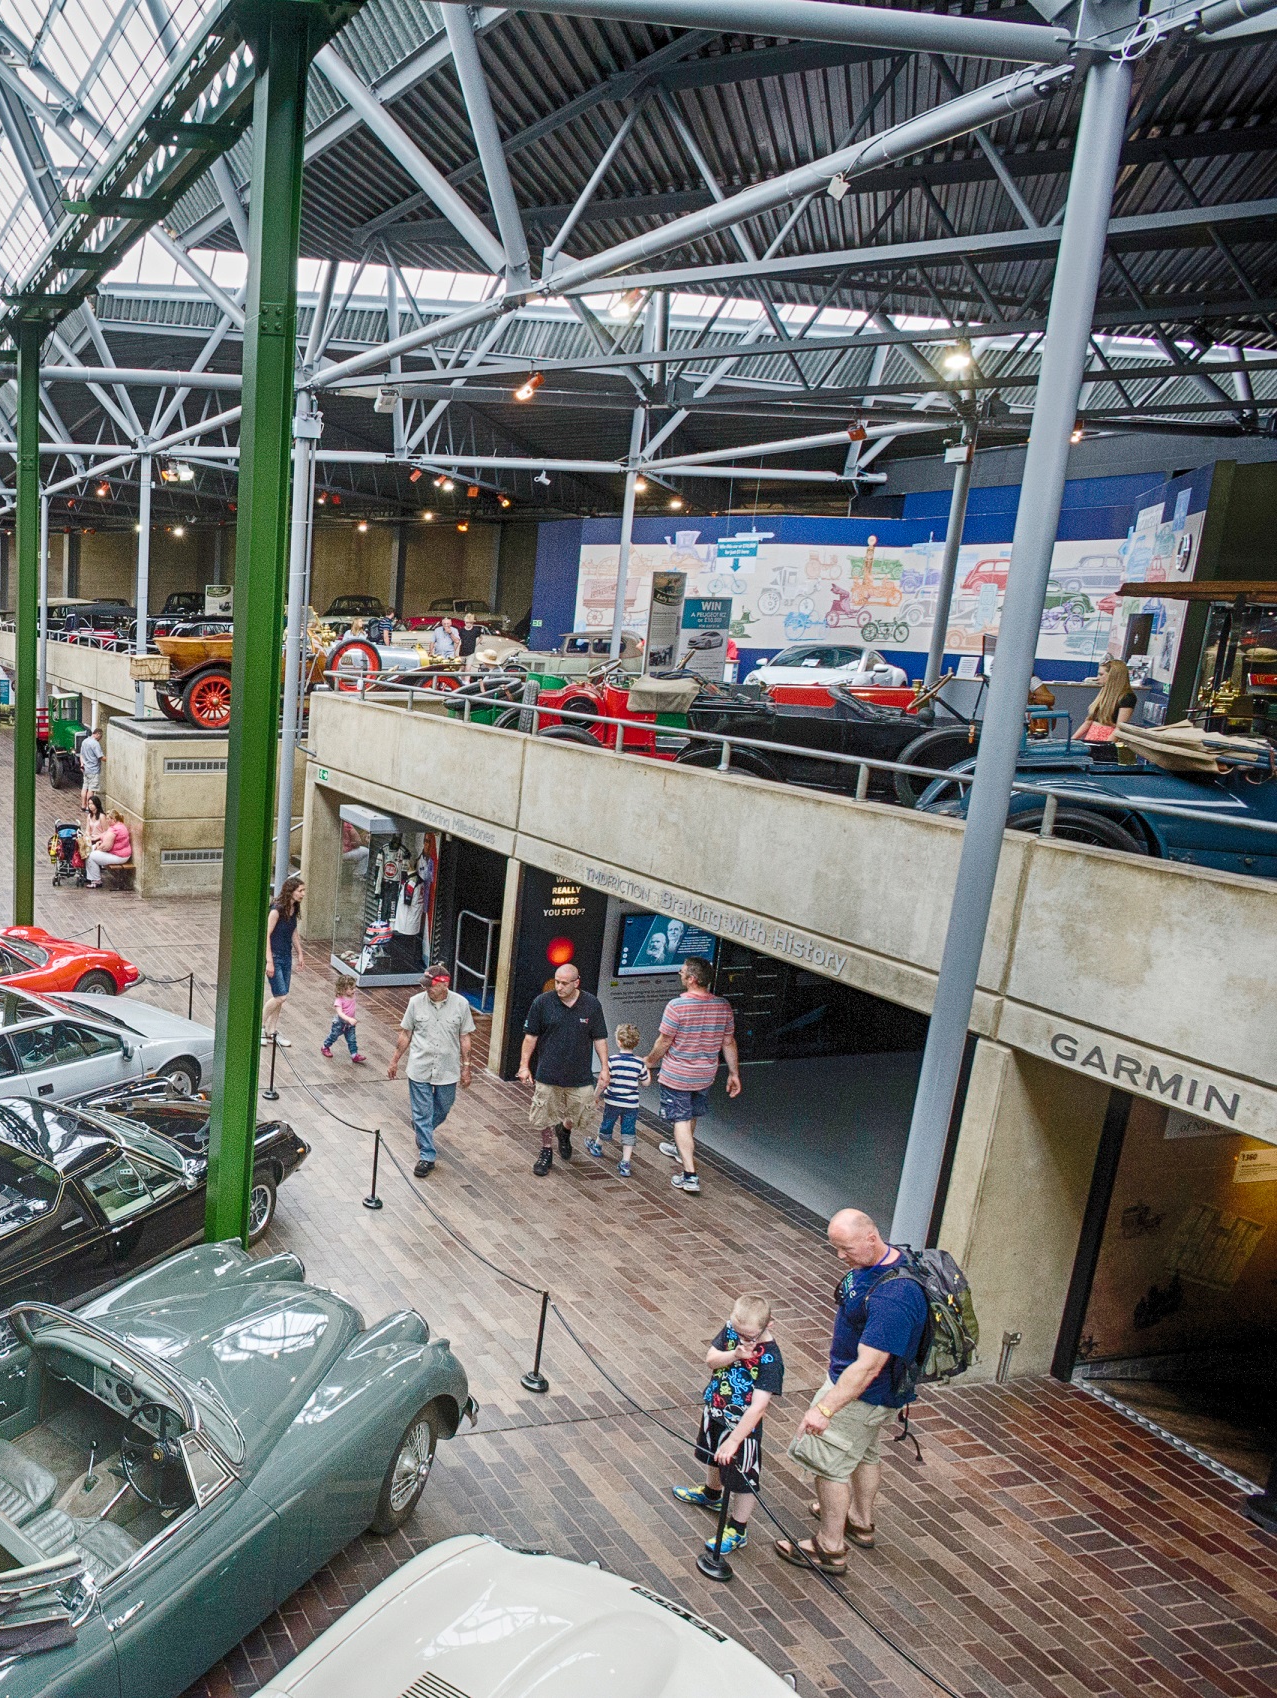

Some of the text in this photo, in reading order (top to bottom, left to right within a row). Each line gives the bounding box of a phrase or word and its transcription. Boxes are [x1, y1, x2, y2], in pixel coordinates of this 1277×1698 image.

[701, 601, 722, 611] WIN
[417, 804, 496, 846] Motoring Milestones
[552, 886, 581, 895] REALLY
[552, 897, 580, 906] MAKES
[544, 908, 586, 917] YOU STOP?
[660, 889, 723, 932] Braking
[727, 914, 767, 946] with
[773, 928, 848, 977] History
[1050, 1032, 1241, 1121] GARMIN
